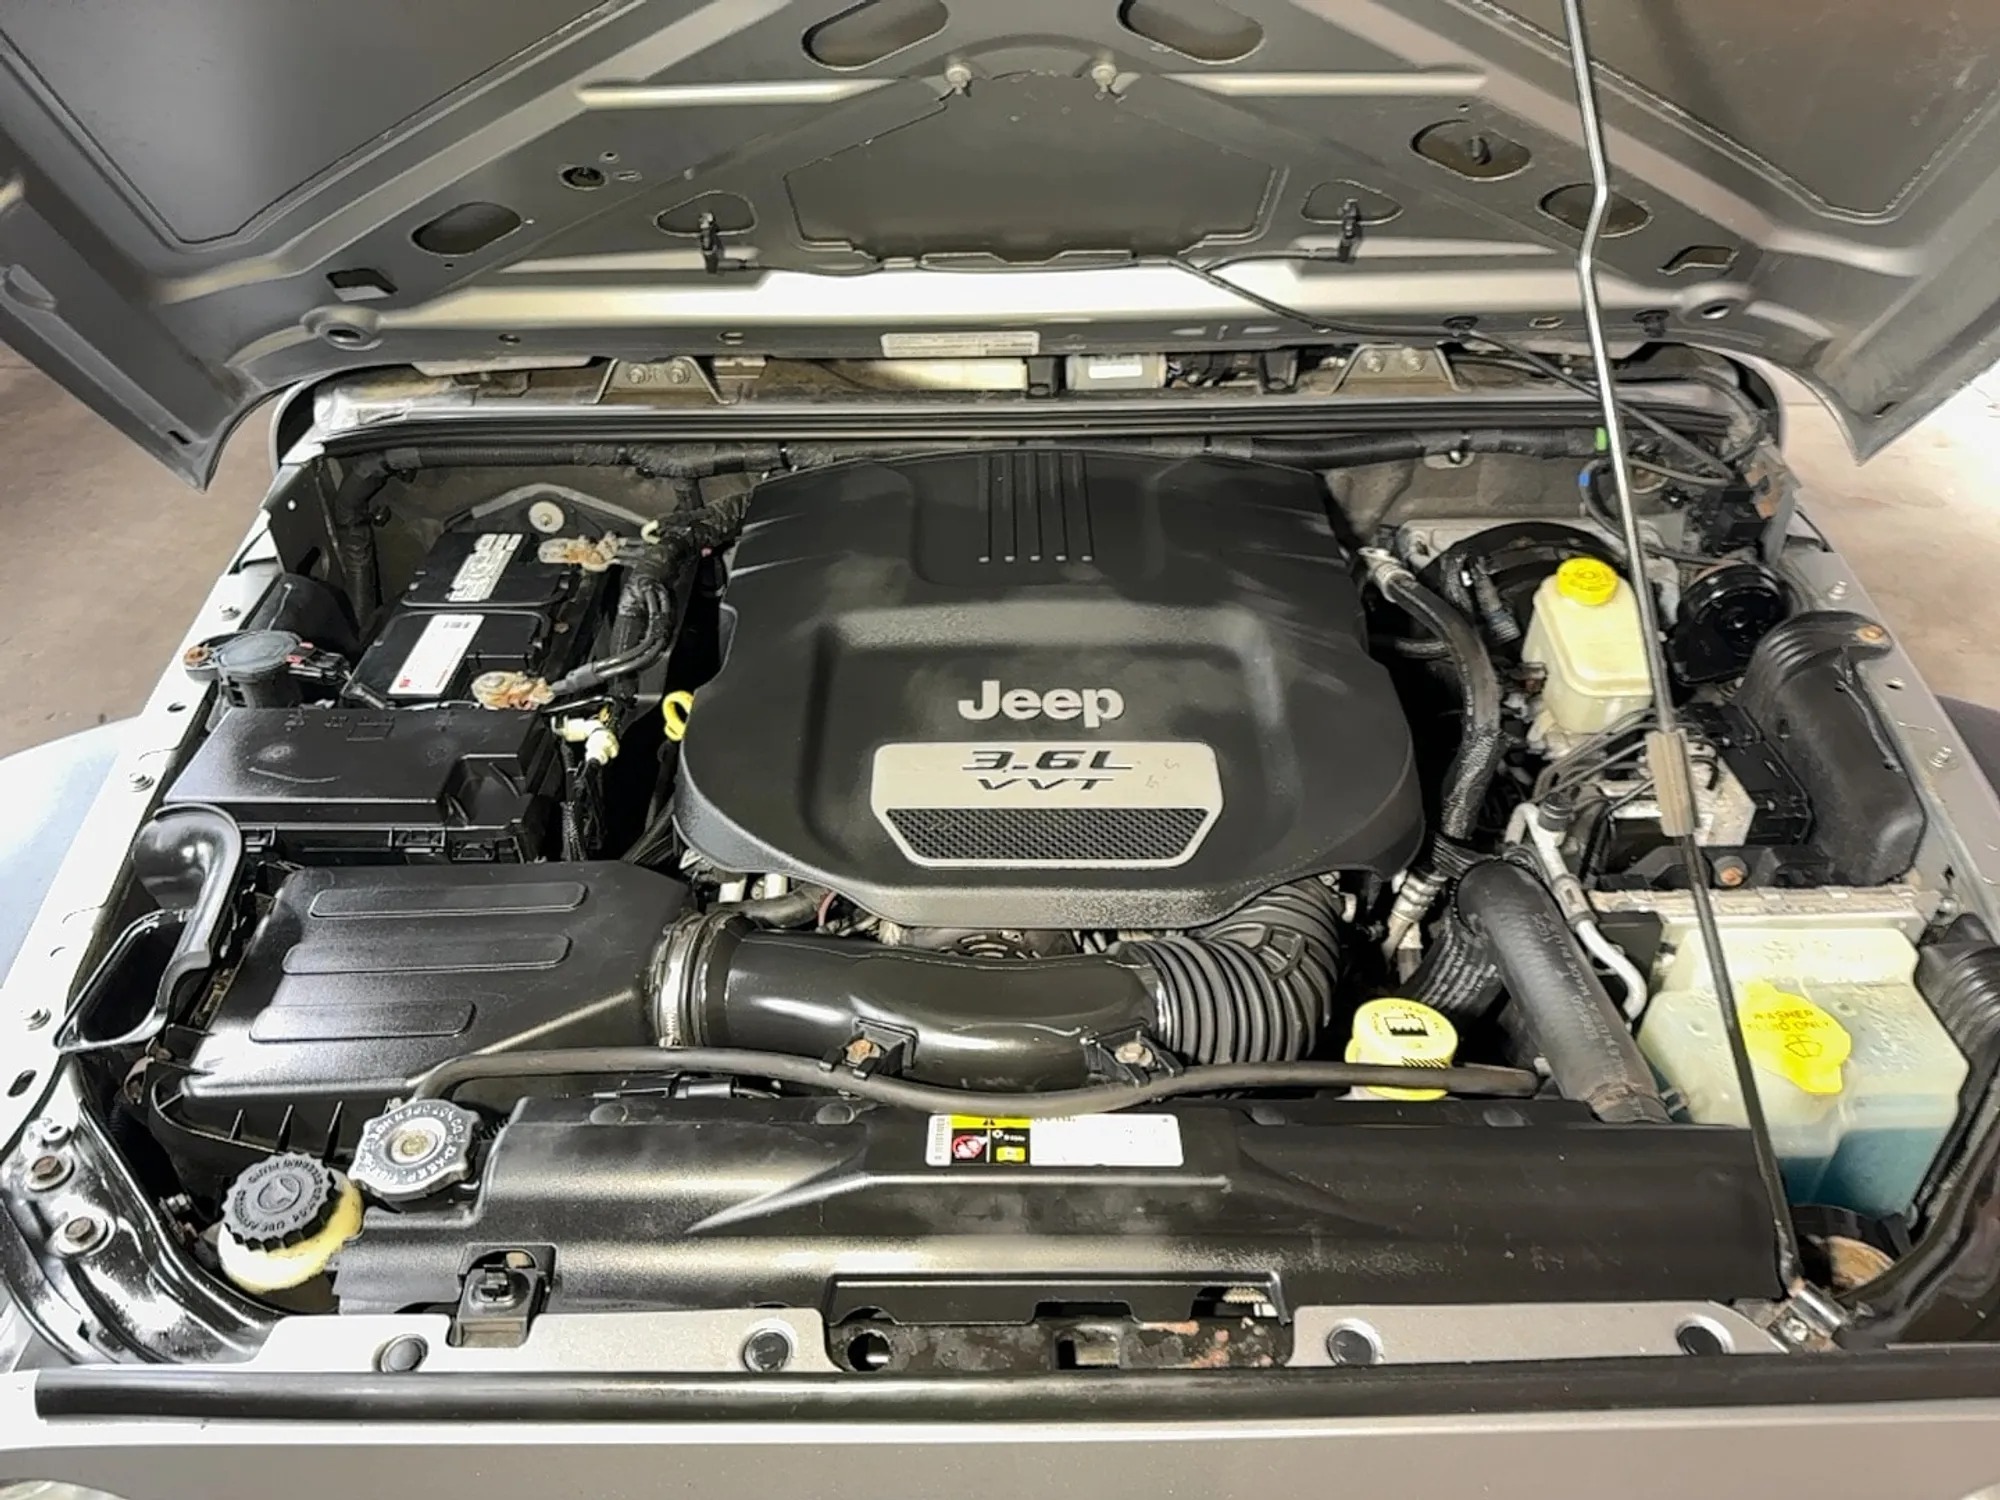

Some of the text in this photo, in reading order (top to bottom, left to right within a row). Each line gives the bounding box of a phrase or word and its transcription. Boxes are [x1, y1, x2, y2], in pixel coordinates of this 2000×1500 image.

[957, 680, 1125, 728] Jeep
[962, 750, 1133, 772] 3.6L
[977, 778, 1114, 790] VVT
